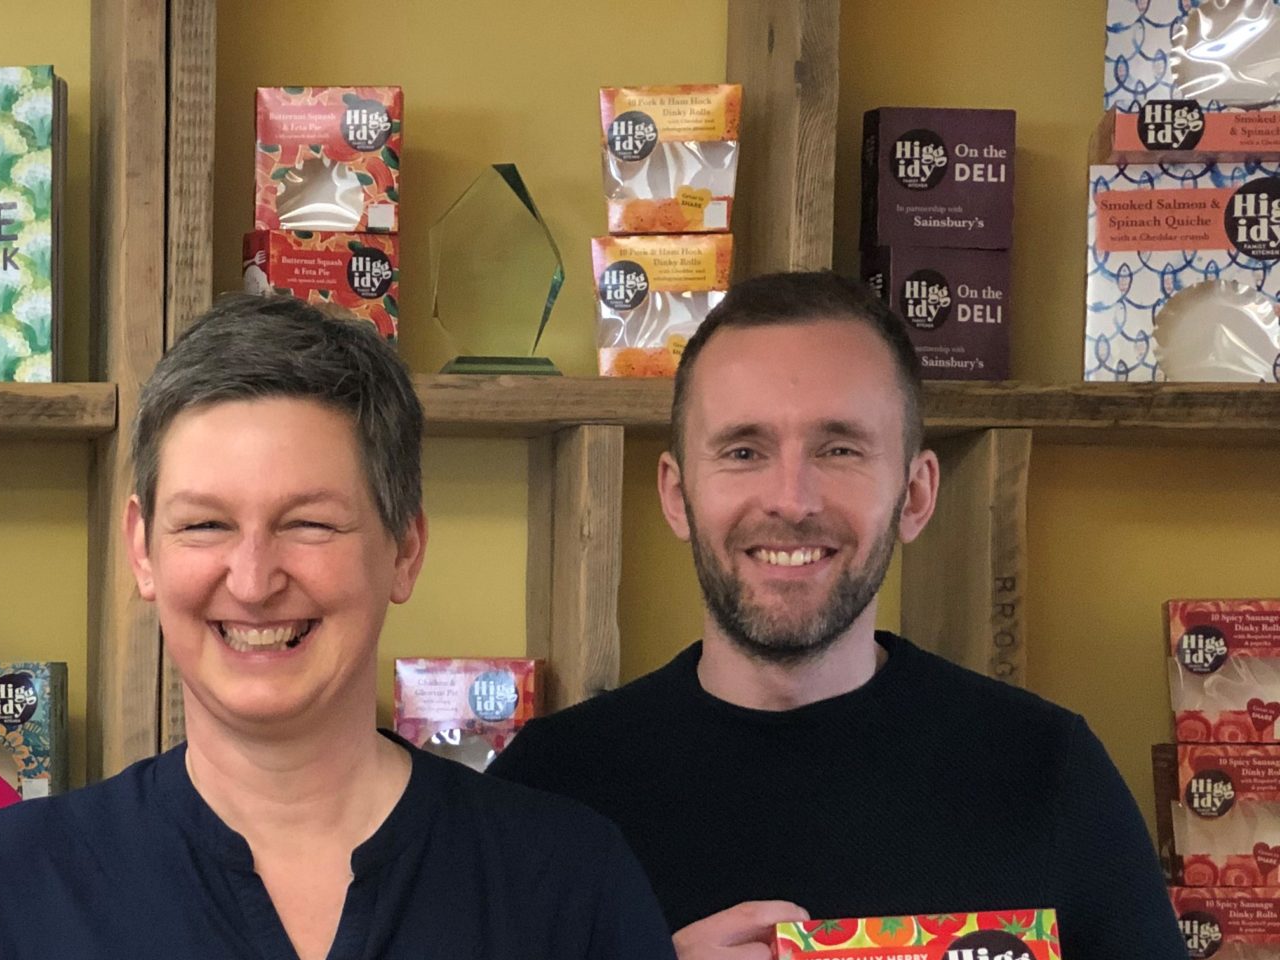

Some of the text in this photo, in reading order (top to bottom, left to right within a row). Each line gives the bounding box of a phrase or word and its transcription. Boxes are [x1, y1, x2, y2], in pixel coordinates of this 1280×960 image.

[662, 108, 711, 118] Dinky Rolls
[1144, 104, 1203, 131] Higg
[1234, 115, 1276, 124] Smoked
[1148, 124, 1189, 148] idy
[1230, 128, 1238, 136] &
[895, 141, 948, 167] Higg
[955, 144, 1007, 159] On the
[898, 160, 936, 182] idy
[954, 164, 1006, 182] DELI
[896, 204, 963, 214] In partnership with
[1100, 200, 1220, 210] Smoked Salmon &
[914, 216, 984, 230] Sainsbury's
[1108, 216, 1212, 230] Spinach Quiche
[1110, 234, 1128, 242] with
[1139, 234, 1178, 242] Cheddar
[1180, 234, 1210, 242] crumb
[282, 256, 342, 268] Butternut Squash
[352, 256, 391, 279] Higg
[653, 258, 702, 268] Dinky Rolls
[294, 267, 330, 276] & Feta Pie
[354, 273, 382, 292] idy
[604, 270, 648, 290] Higg
[606, 284, 638, 302] idy
[957, 284, 1002, 299] On the
[957, 304, 1002, 324] DELI
[922, 356, 984, 370] Sainsbury's
[1211, 614, 1279, 624] 10 Spicy Sausage
[1234, 624, 1258, 632] Dinky
[1182, 634, 1227, 655] Higg
[1185, 650, 1217, 667] idy
[1242, 768, 1266, 777] Dinky
[1229, 910, 1254, 920] Dinky
